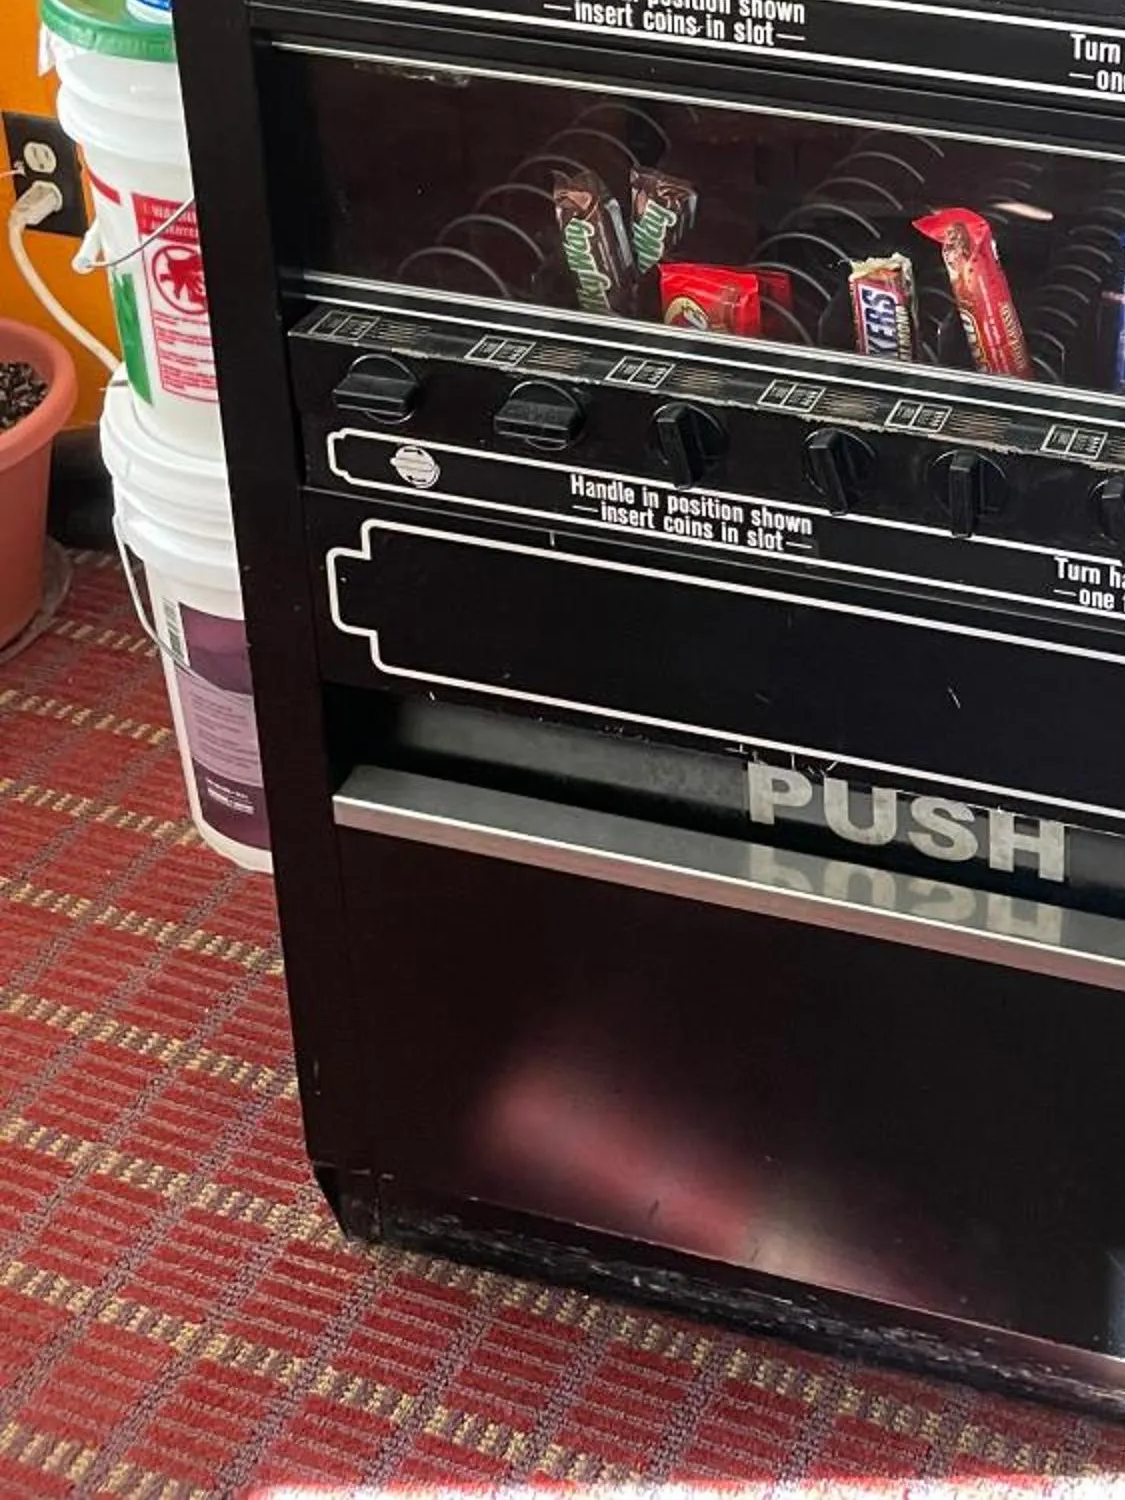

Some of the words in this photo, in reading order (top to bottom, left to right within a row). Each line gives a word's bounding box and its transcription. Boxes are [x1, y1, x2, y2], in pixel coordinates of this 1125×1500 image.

[643, 9, 698, 37] coins
[706, 14, 725, 39] in
[1070, 33, 1121, 65] Turn
[570, 473, 635, 505] Handle
[641, 486, 659, 509] in
[667, 493, 744, 524] position
[750, 505, 813, 535] shown
[663, 514, 713, 539] coins
[721, 521, 739, 544] in
[1053, 556, 1101, 585] Turn
[747, 761, 1066, 883] PUSH
